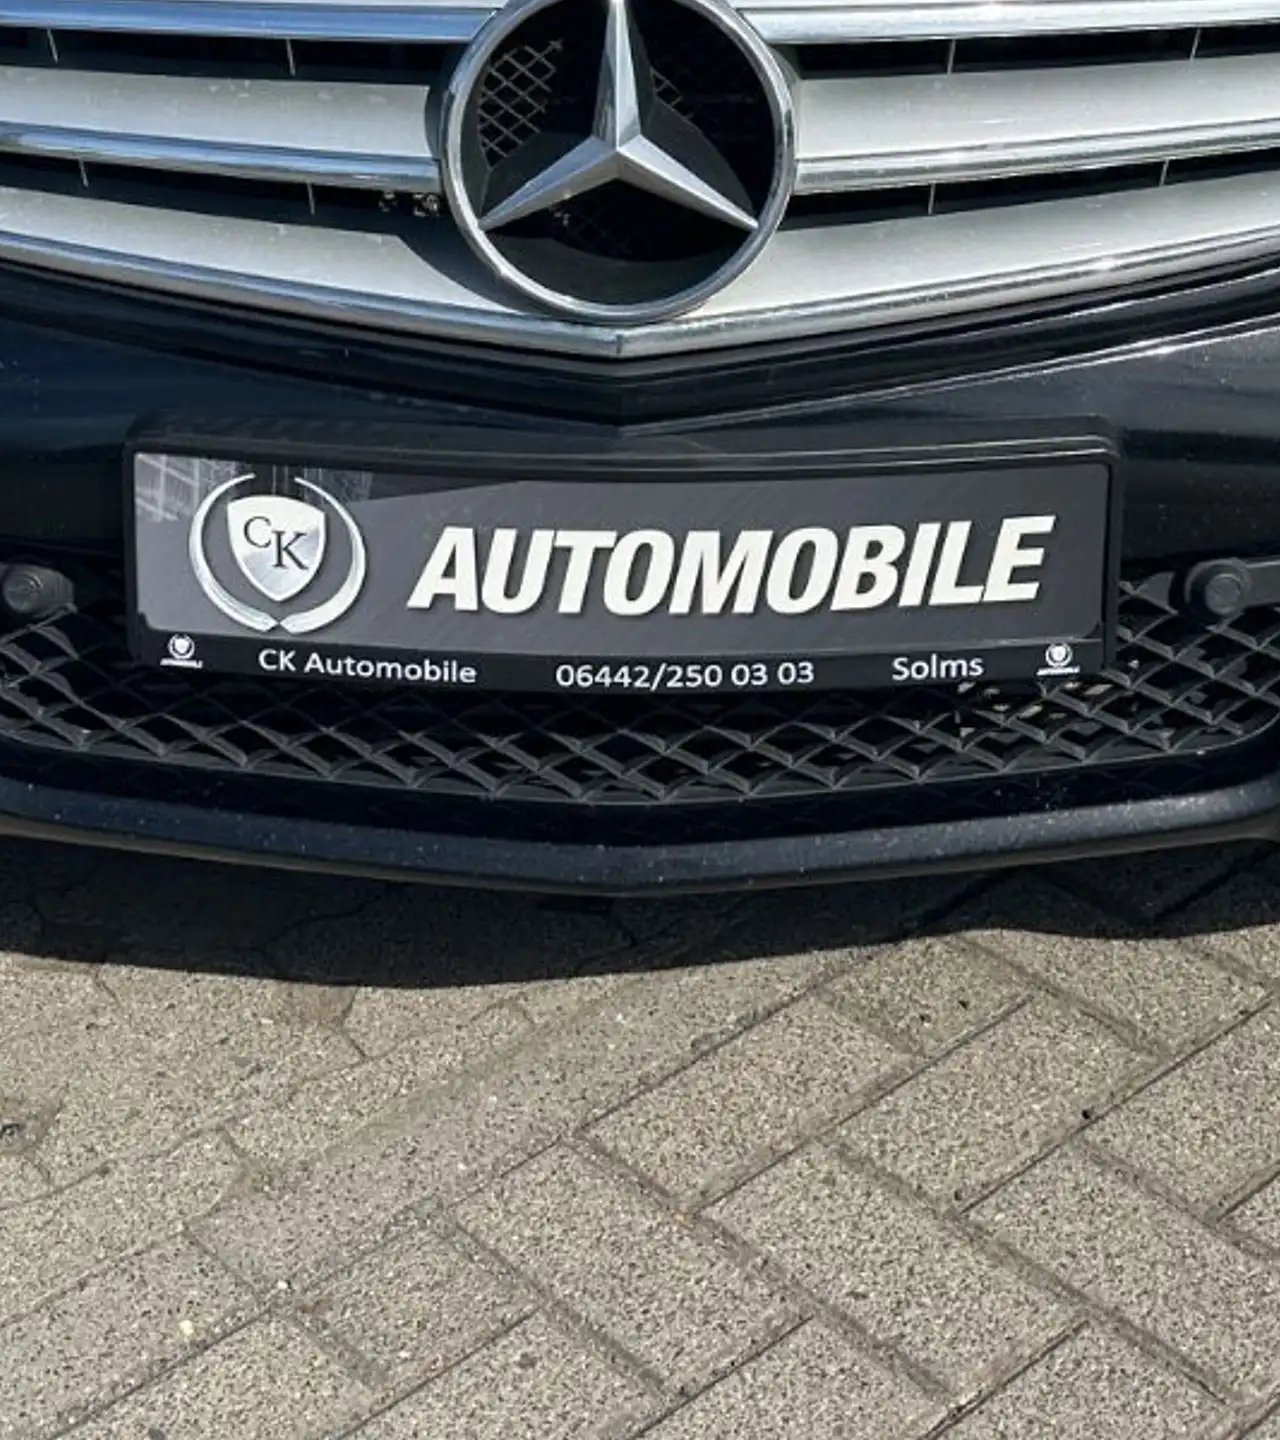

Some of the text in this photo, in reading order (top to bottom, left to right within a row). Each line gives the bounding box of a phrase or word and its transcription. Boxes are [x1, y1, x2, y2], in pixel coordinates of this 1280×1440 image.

[243, 516, 309, 570] CK
[406, 514, 1055, 617] AUTOMOBILE
[258, 648, 985, 691] CK Automobile 06442/250 03 03 Solms
